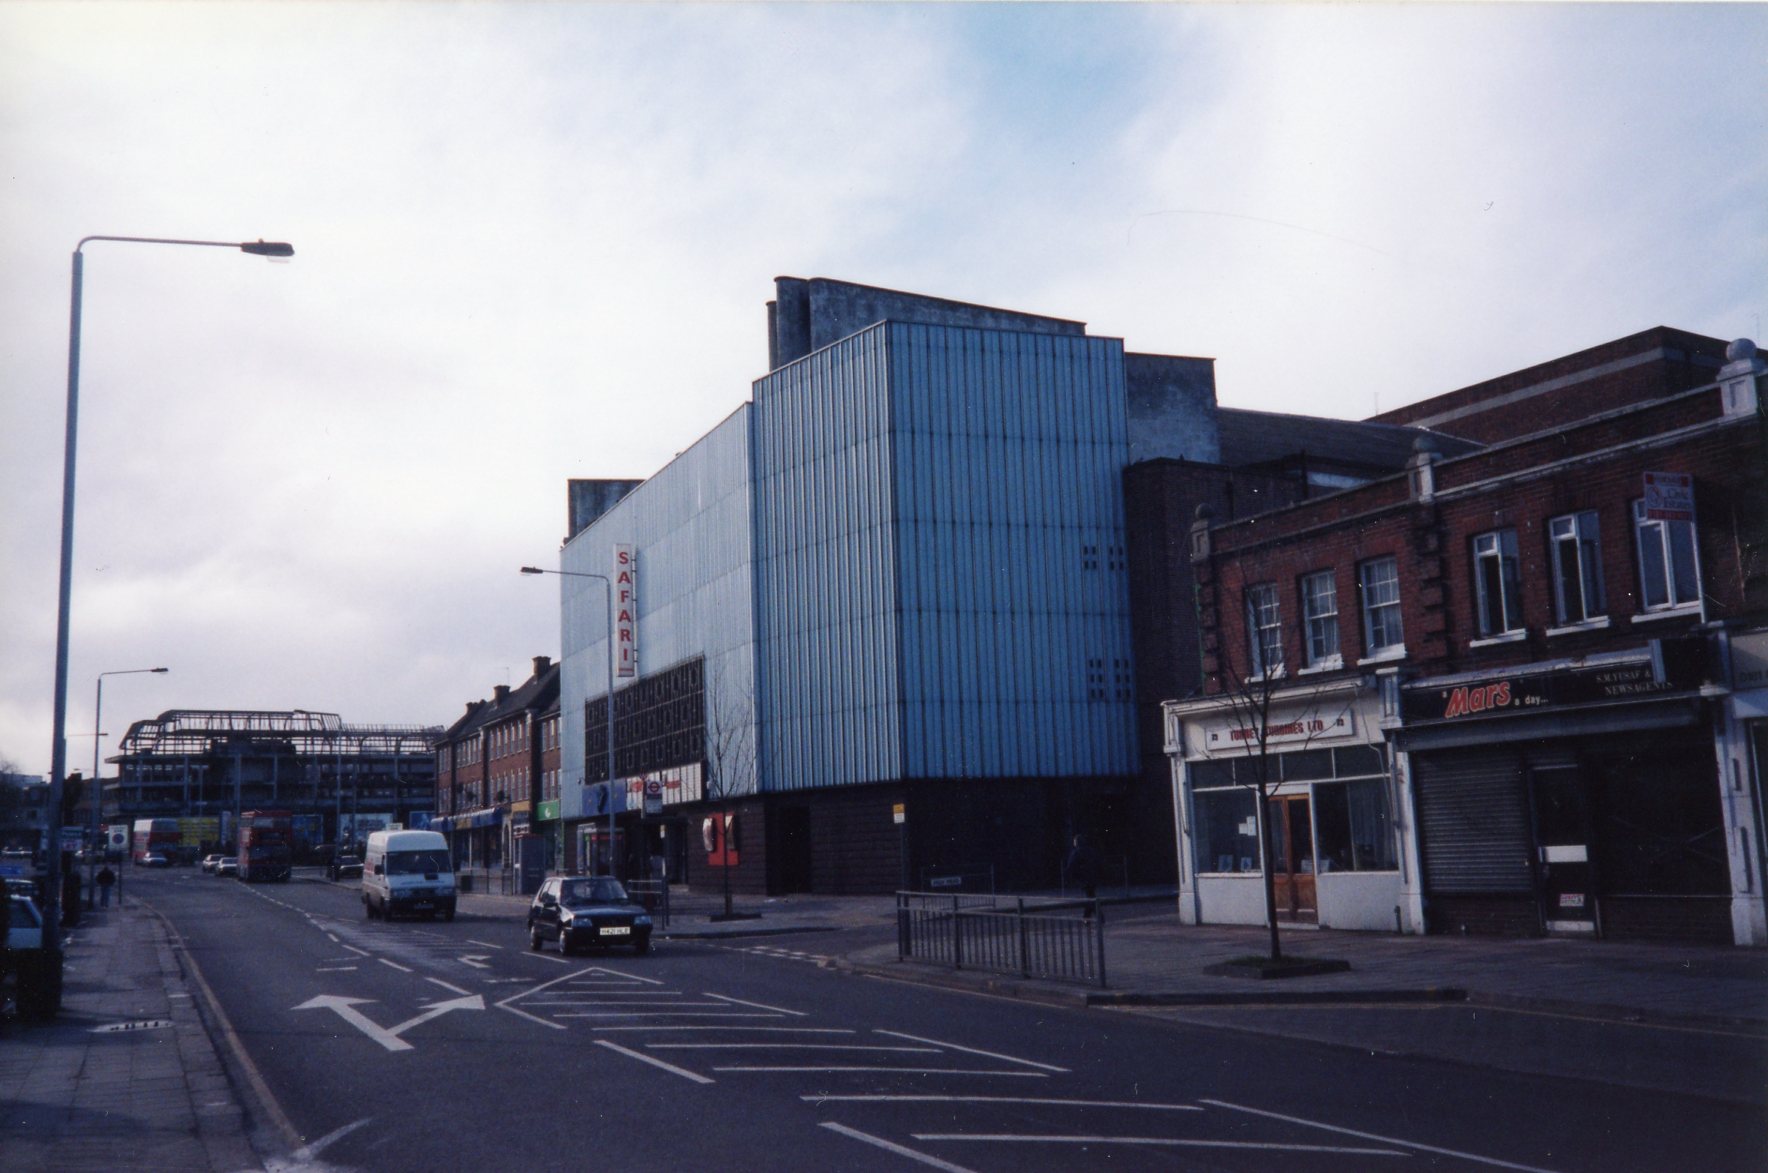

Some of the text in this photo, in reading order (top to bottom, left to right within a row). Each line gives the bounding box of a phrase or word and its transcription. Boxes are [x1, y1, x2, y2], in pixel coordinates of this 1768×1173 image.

[618, 551, 631, 661] SAFARI
[1445, 681, 1511, 719] Mars
[1604, 681, 1673, 697] NEWSAGENTS
[1307, 719, 1323, 733] LTD
